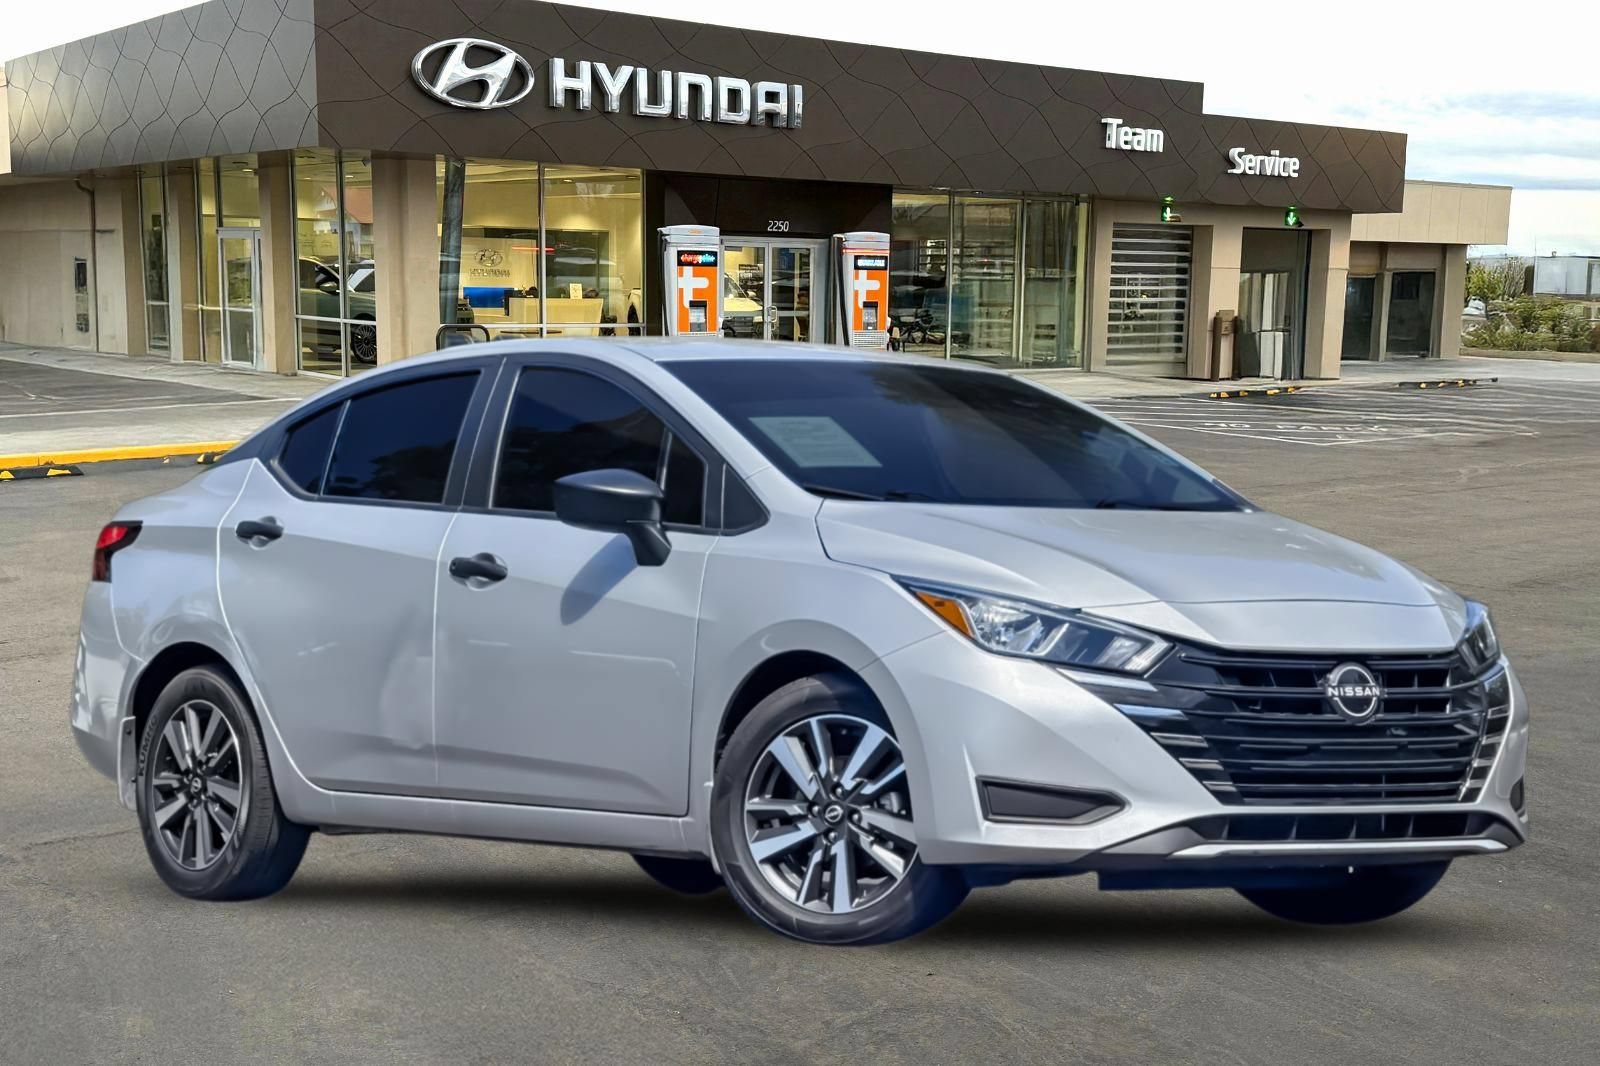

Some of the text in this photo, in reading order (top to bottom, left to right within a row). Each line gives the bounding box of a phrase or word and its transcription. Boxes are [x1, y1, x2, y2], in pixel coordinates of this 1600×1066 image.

[549, 57, 803, 129] HYUNDAI
[1101, 117, 1164, 153] Team
[1227, 147, 1300, 178] Service
[767, 220, 790, 232] 2250
[1327, 686, 1380, 697] NISSAN
